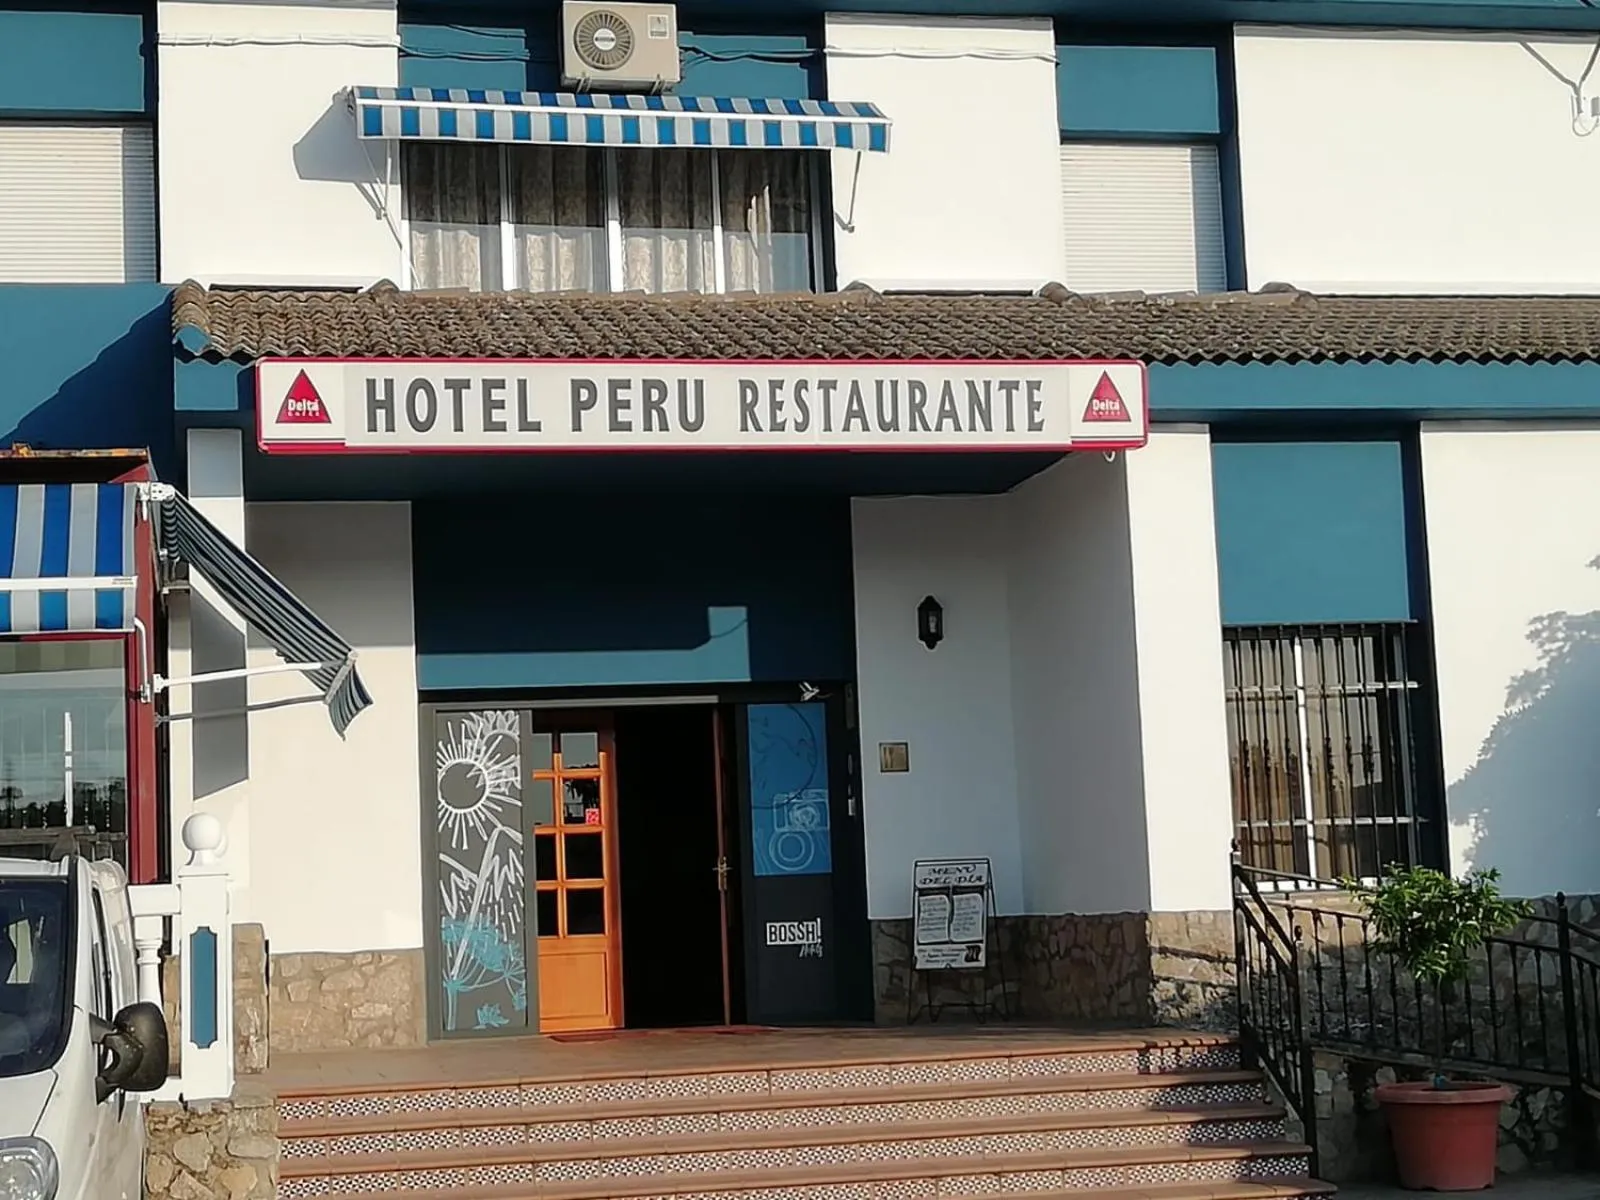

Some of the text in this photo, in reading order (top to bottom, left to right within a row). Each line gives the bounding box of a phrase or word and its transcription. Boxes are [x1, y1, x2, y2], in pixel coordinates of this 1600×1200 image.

[287, 398, 320, 412] Delta
[365, 377, 1046, 434] HOTEL PERU RESTAURANTE
[1092, 398, 1121, 412] Delta
